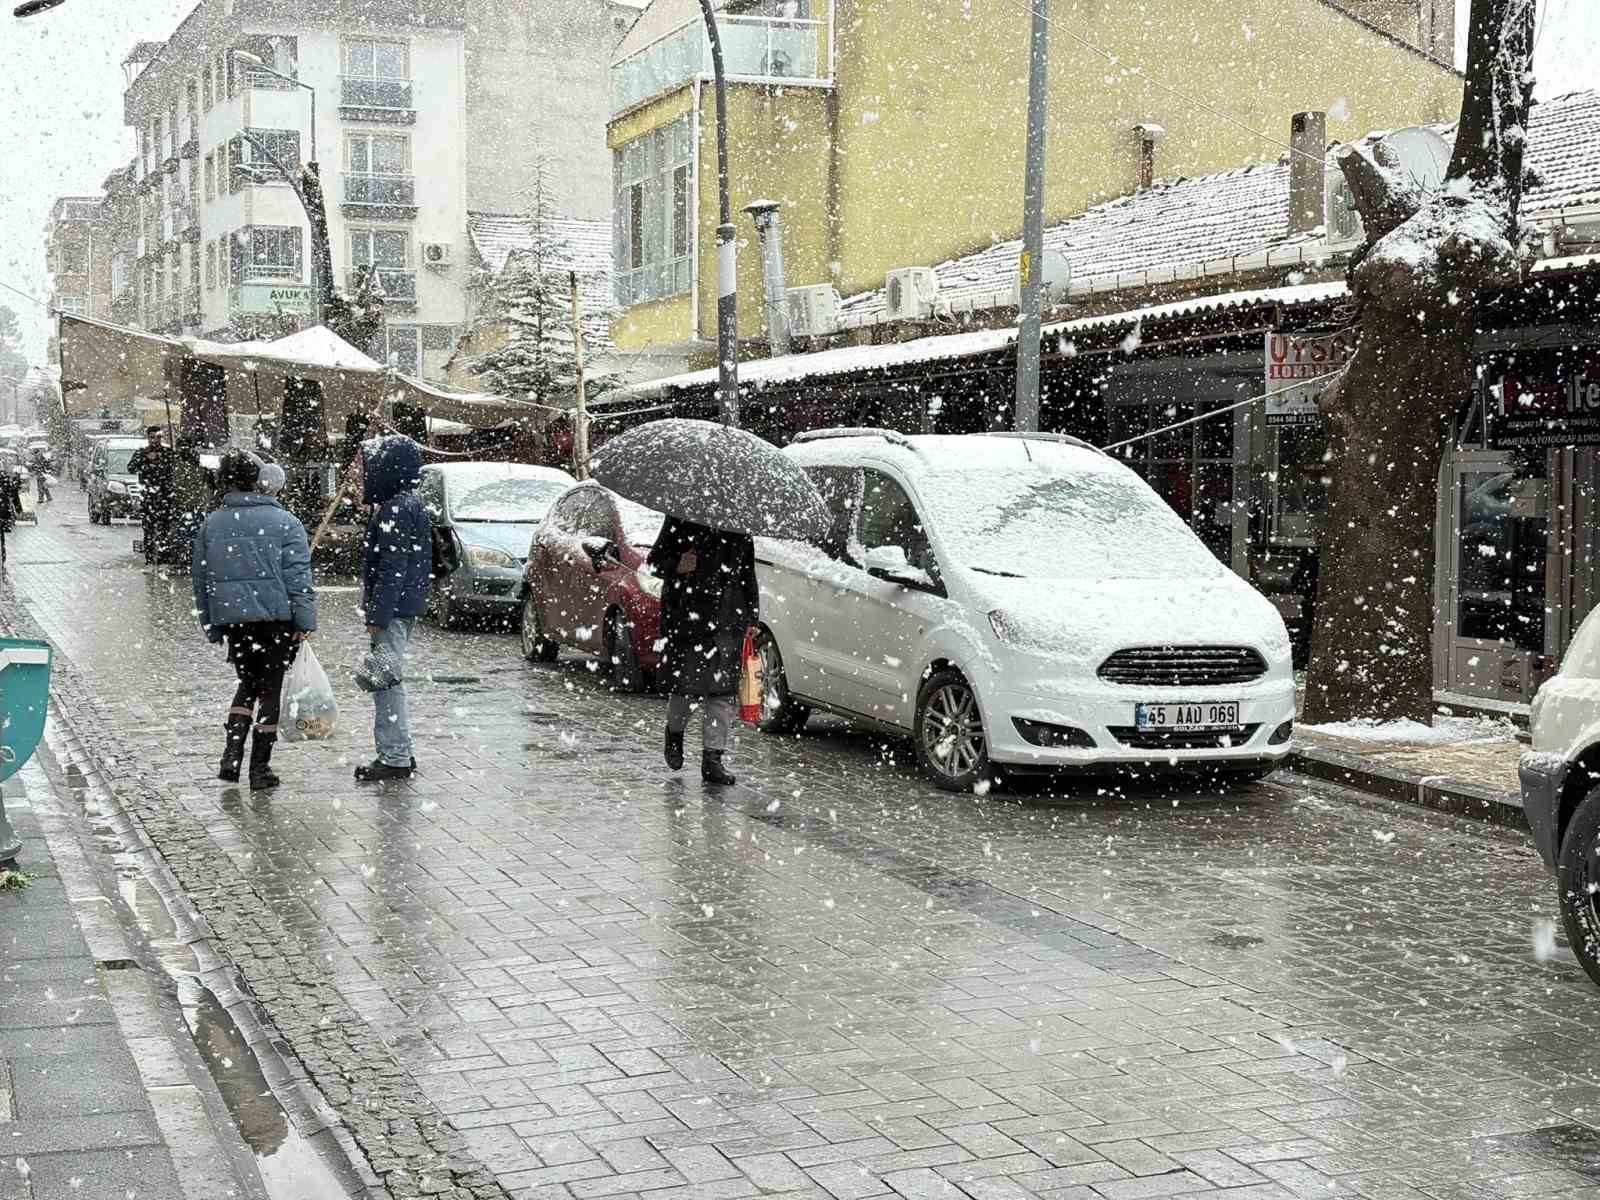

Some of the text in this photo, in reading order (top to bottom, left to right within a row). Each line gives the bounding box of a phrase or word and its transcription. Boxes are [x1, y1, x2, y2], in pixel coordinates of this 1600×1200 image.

[270, 290, 309, 299] AVUKA
[1270, 336, 1348, 362] UYSA
[1149, 707, 1166, 725] 45
[1176, 706, 1202, 723] AAD
[1210, 705, 1235, 723] 069
